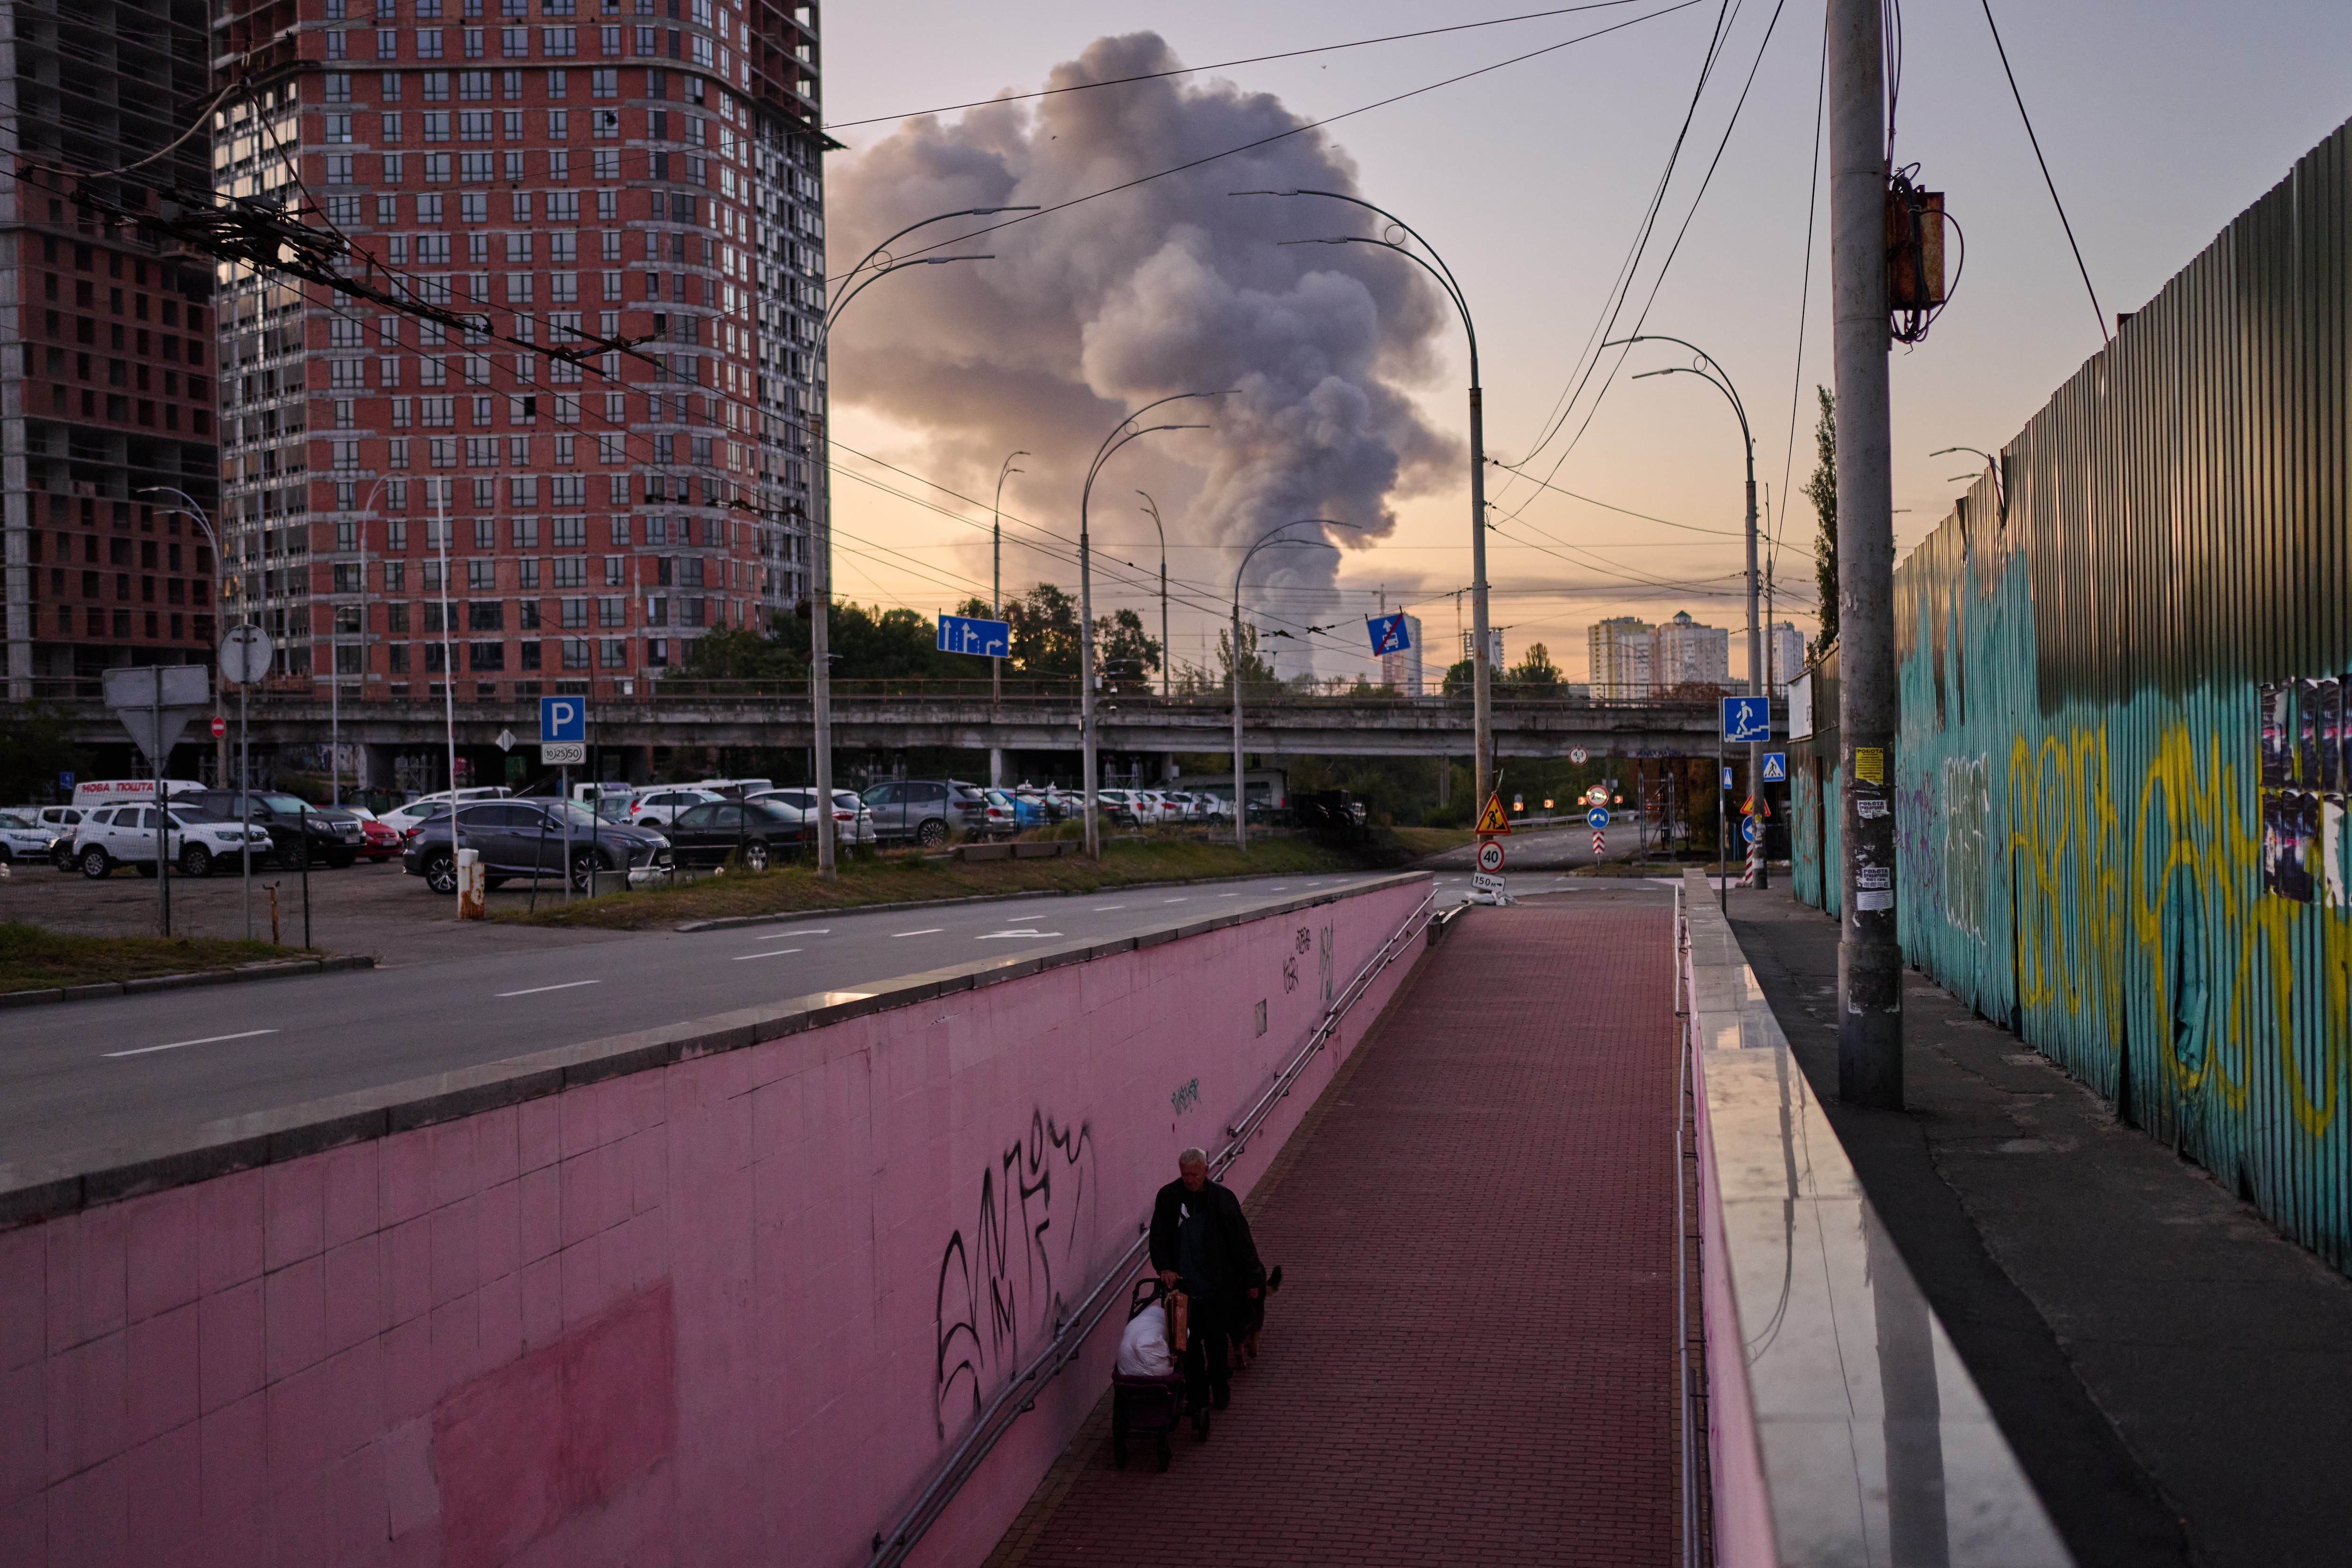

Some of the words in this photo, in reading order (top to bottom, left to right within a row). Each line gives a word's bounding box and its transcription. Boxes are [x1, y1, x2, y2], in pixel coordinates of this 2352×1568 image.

[552, 702, 574, 736] P
[568, 749, 579, 758] 50
[82, 783, 110, 793] НОВА
[117, 782, 154, 792] ПОШТА
[1483, 850, 1499, 863] 40
